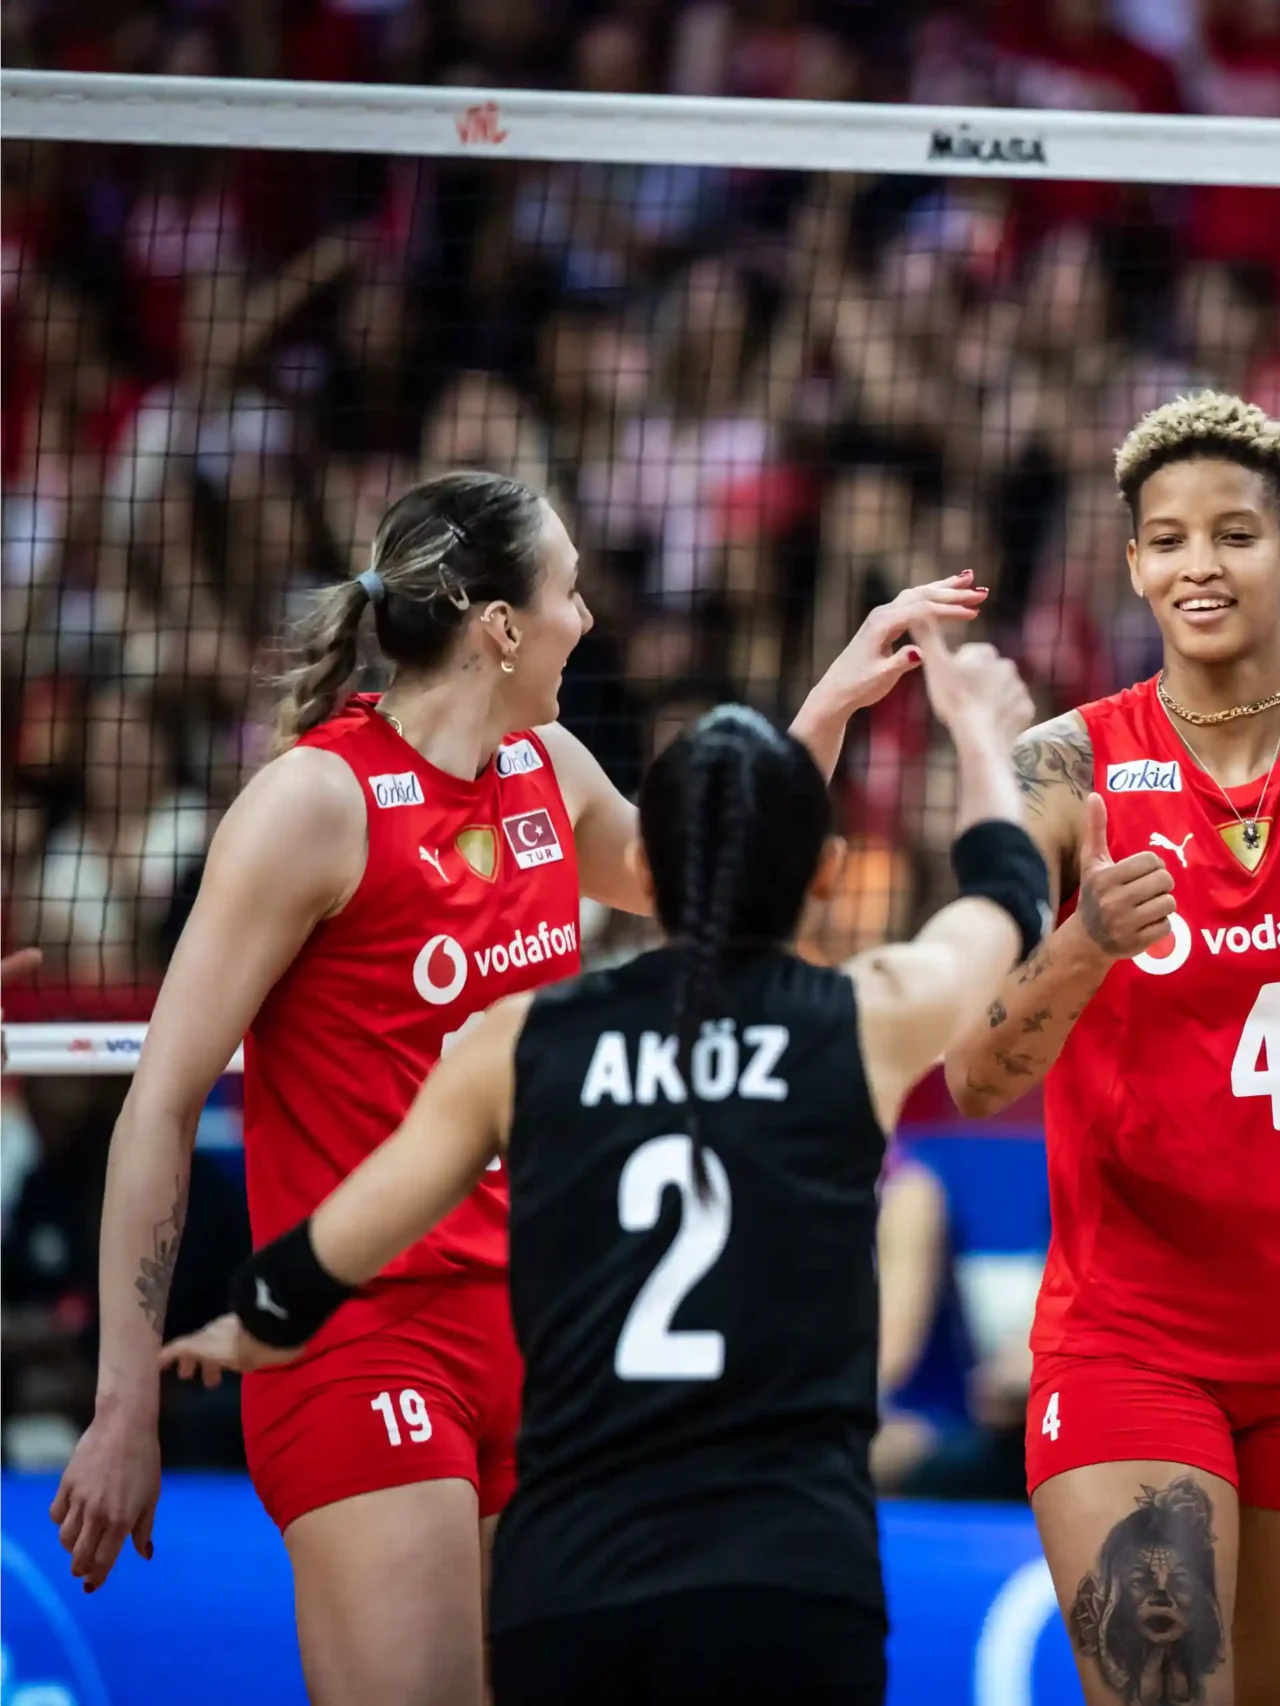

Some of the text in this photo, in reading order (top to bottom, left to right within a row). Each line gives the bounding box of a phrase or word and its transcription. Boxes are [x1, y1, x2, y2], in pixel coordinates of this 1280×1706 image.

[376, 776, 420, 805] Orkid
[1109, 761, 1177, 790] Orkid
[527, 850, 554, 863] TUR
[474, 921, 577, 977] vodafon
[580, 1017, 789, 1106] AKÖZ
[614, 1134, 732, 1381] 2
[371, 1389, 432, 1446] 19
[1041, 1392, 1061, 1441] 4
